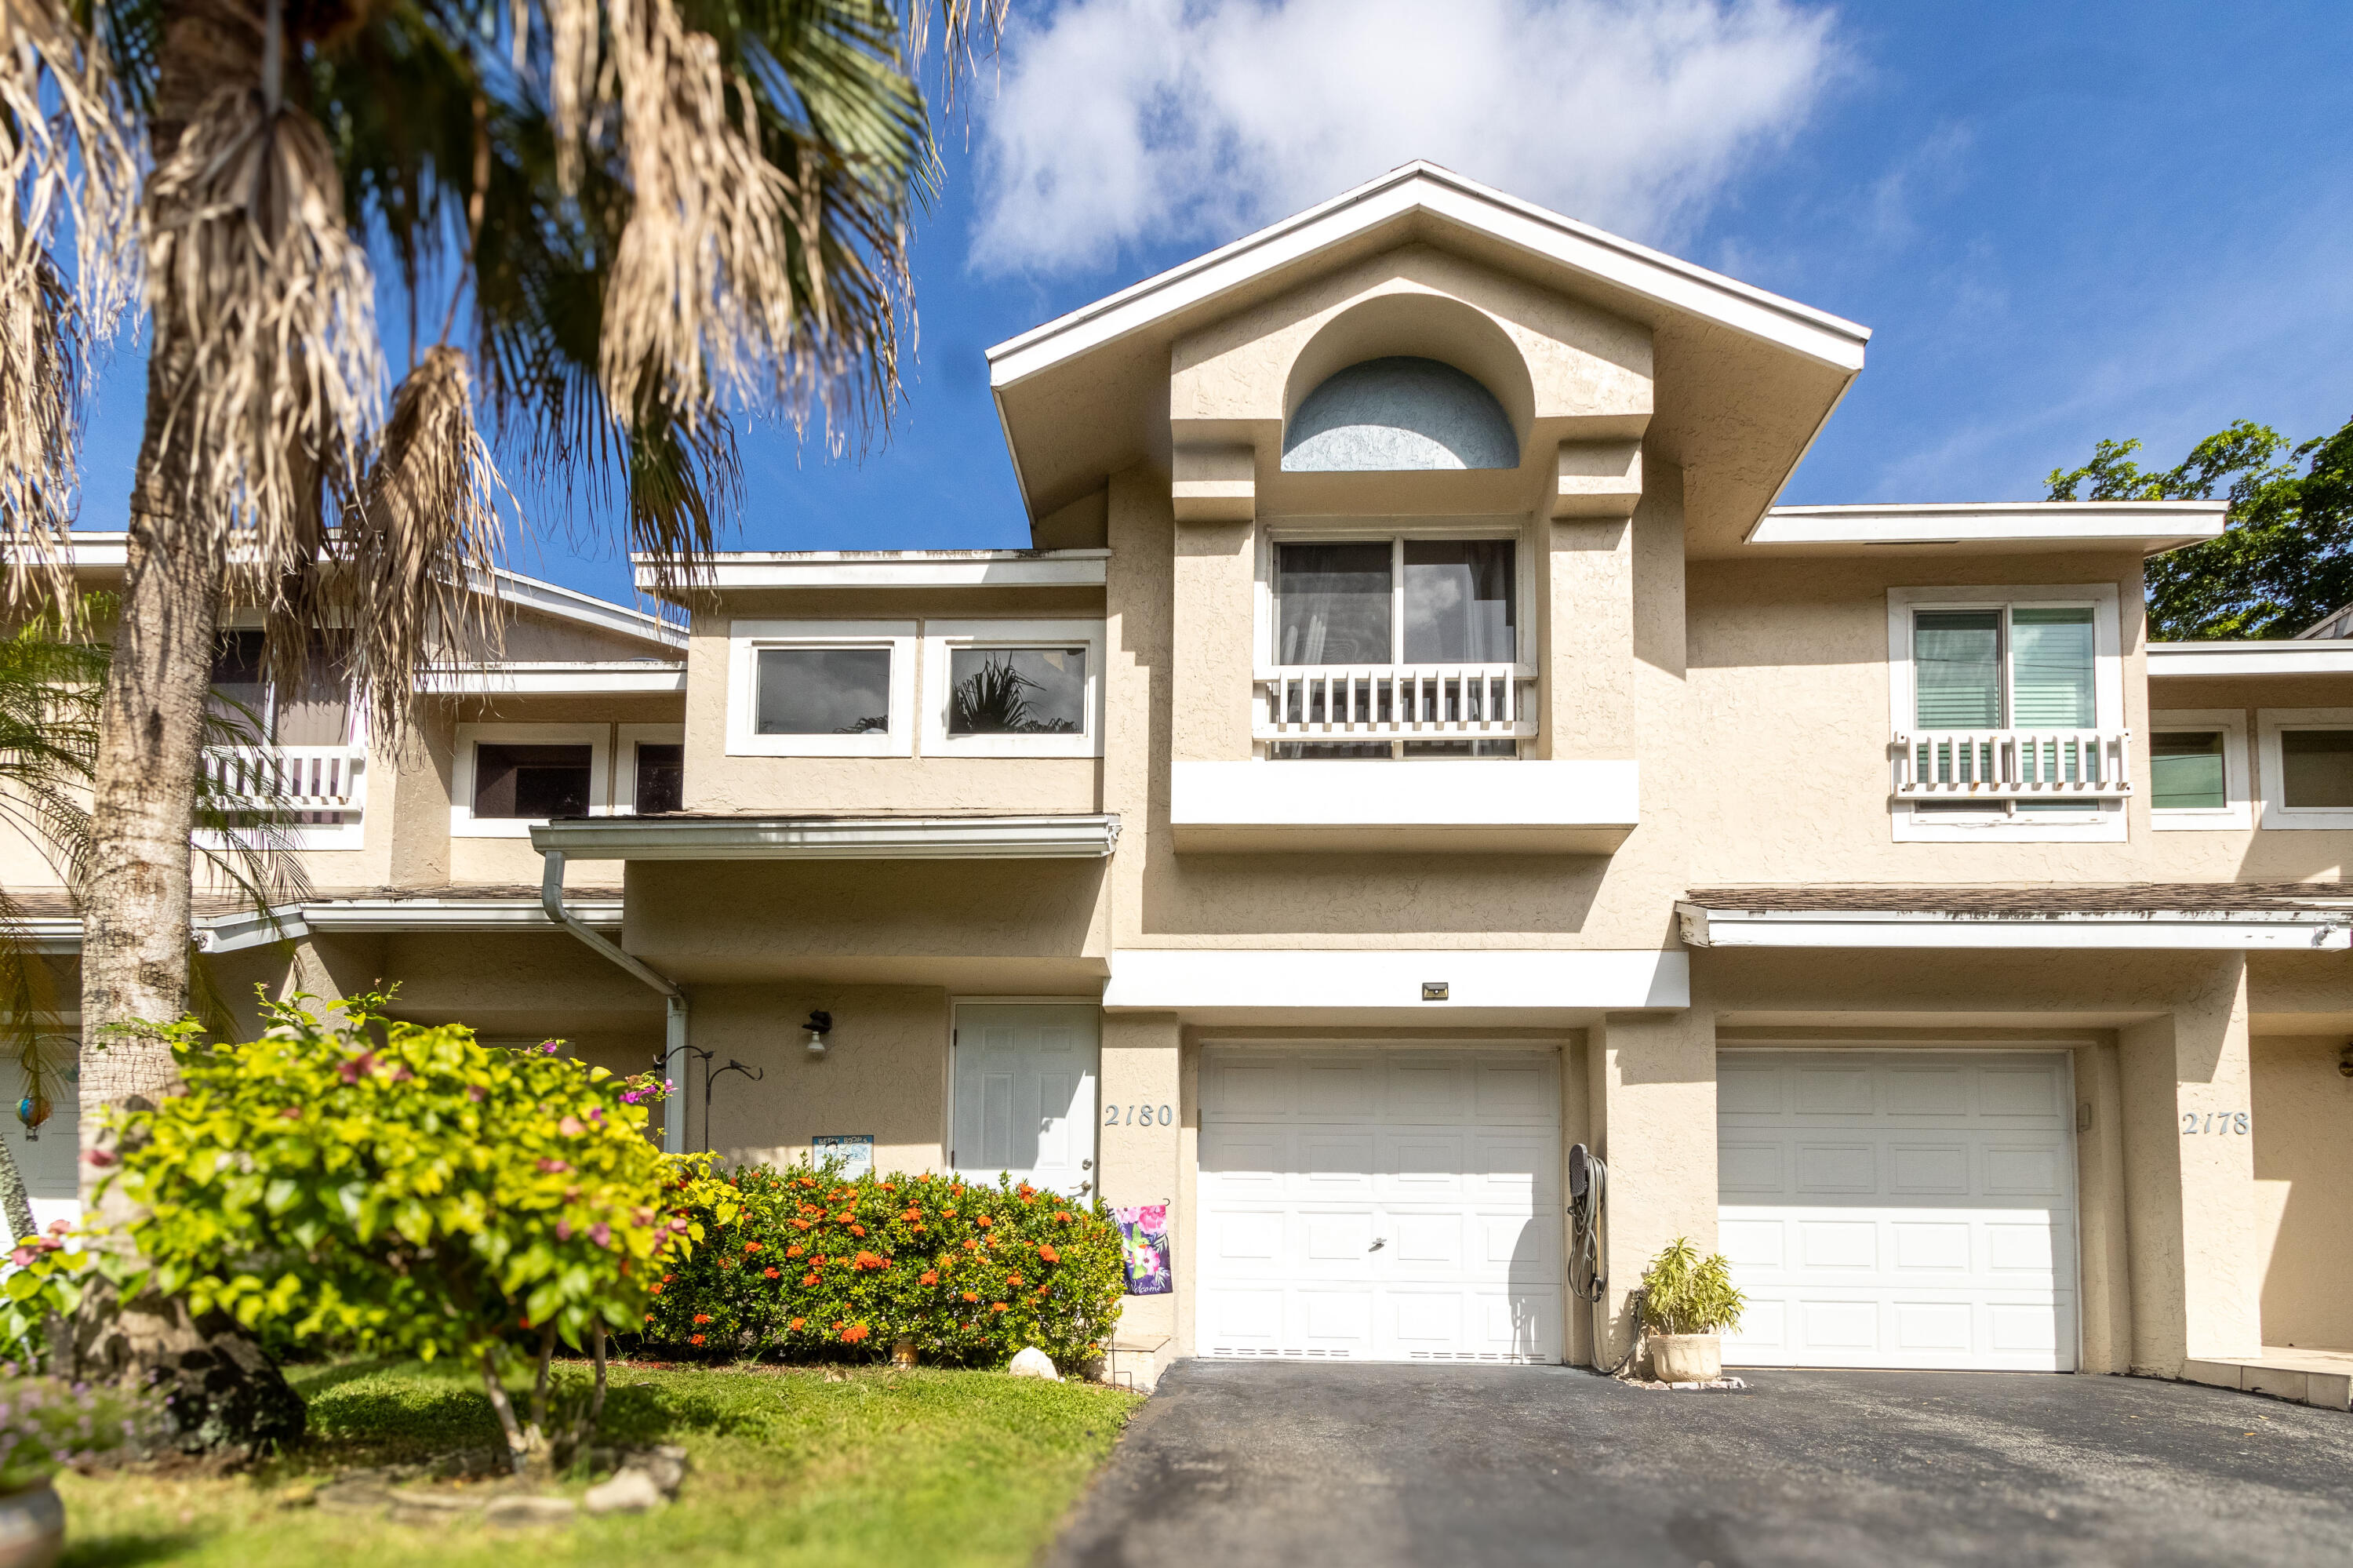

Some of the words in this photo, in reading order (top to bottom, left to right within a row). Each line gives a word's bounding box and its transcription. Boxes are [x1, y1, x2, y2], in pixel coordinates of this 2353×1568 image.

[1104, 1104, 1173, 1126] 2180
[2183, 1112, 2249, 1135] 2178
[1125, 1279, 1162, 1294] Welcome
